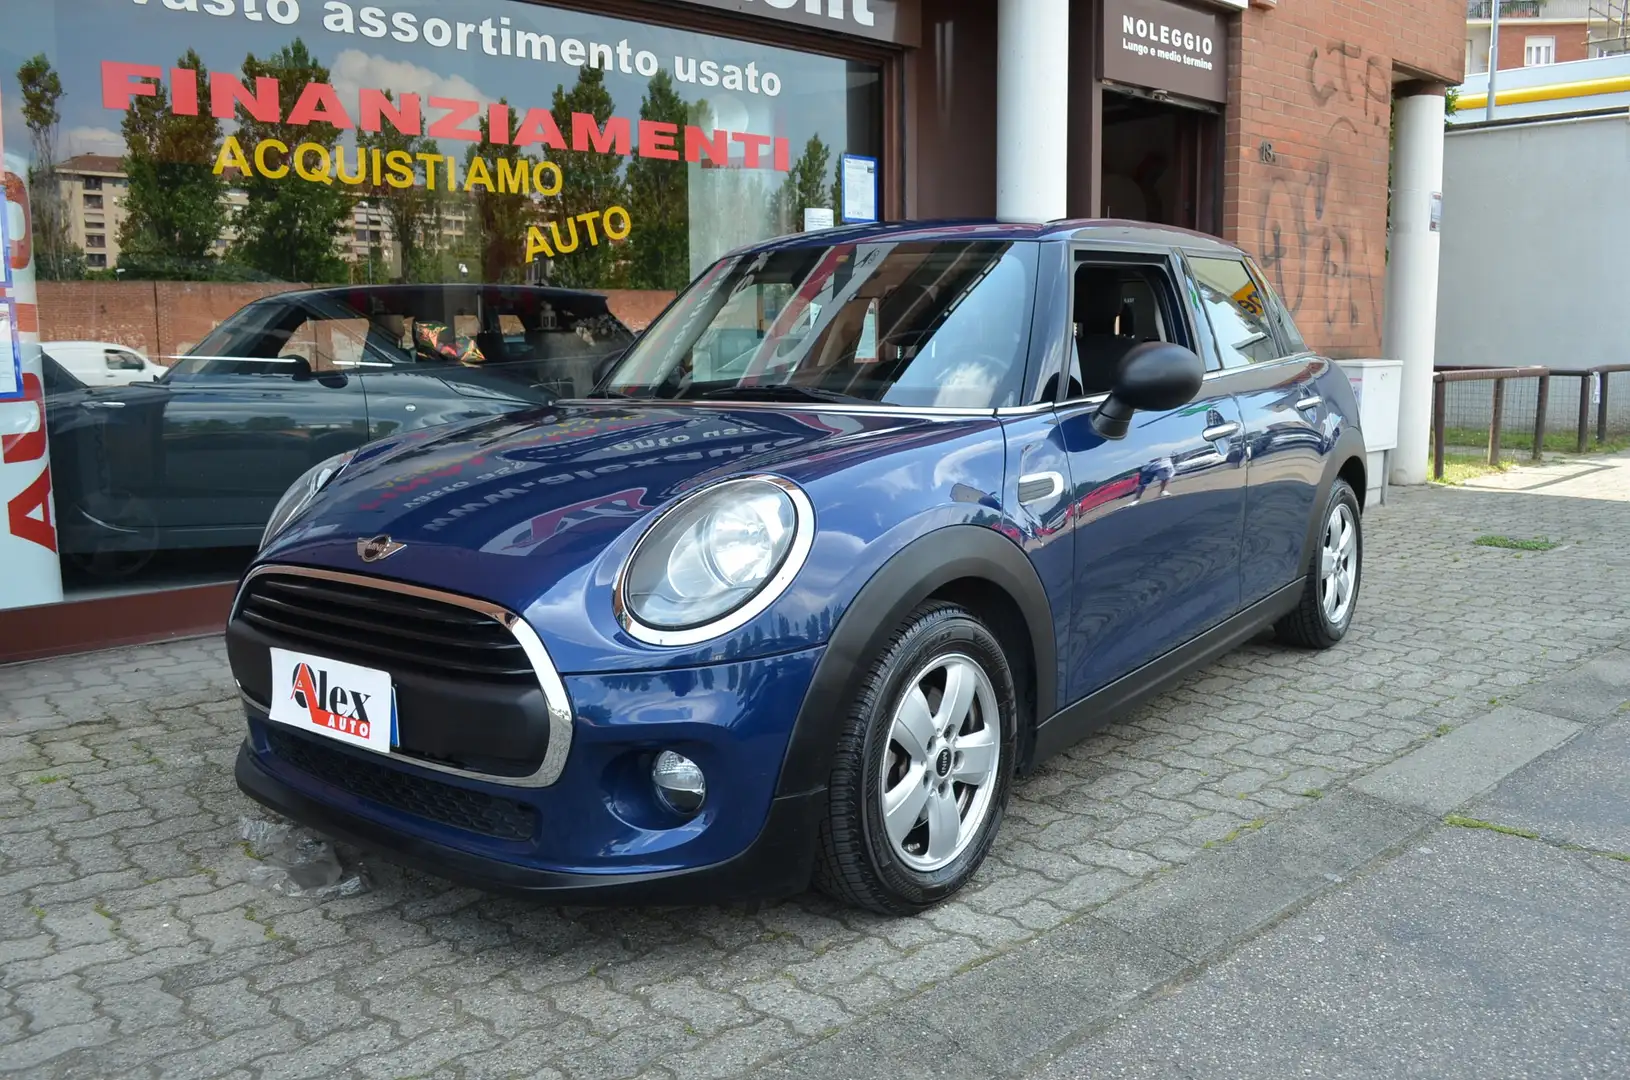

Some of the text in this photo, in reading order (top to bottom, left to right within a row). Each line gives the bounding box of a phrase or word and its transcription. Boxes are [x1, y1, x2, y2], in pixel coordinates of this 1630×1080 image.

[323, 2, 658, 77] assortimento
[674, 56, 782, 97] usato
[1122, 14, 1213, 55] NOLEGGIO
[1122, 37, 1213, 71] Lungo e medio termine
[101, 60, 790, 171] FINANZIAMENTI
[212, 136, 563, 196] ACQUISTIAMO
[524, 206, 632, 263] AUTO
[290, 662, 371, 723] Alex
[327, 714, 369, 737] AUTO
